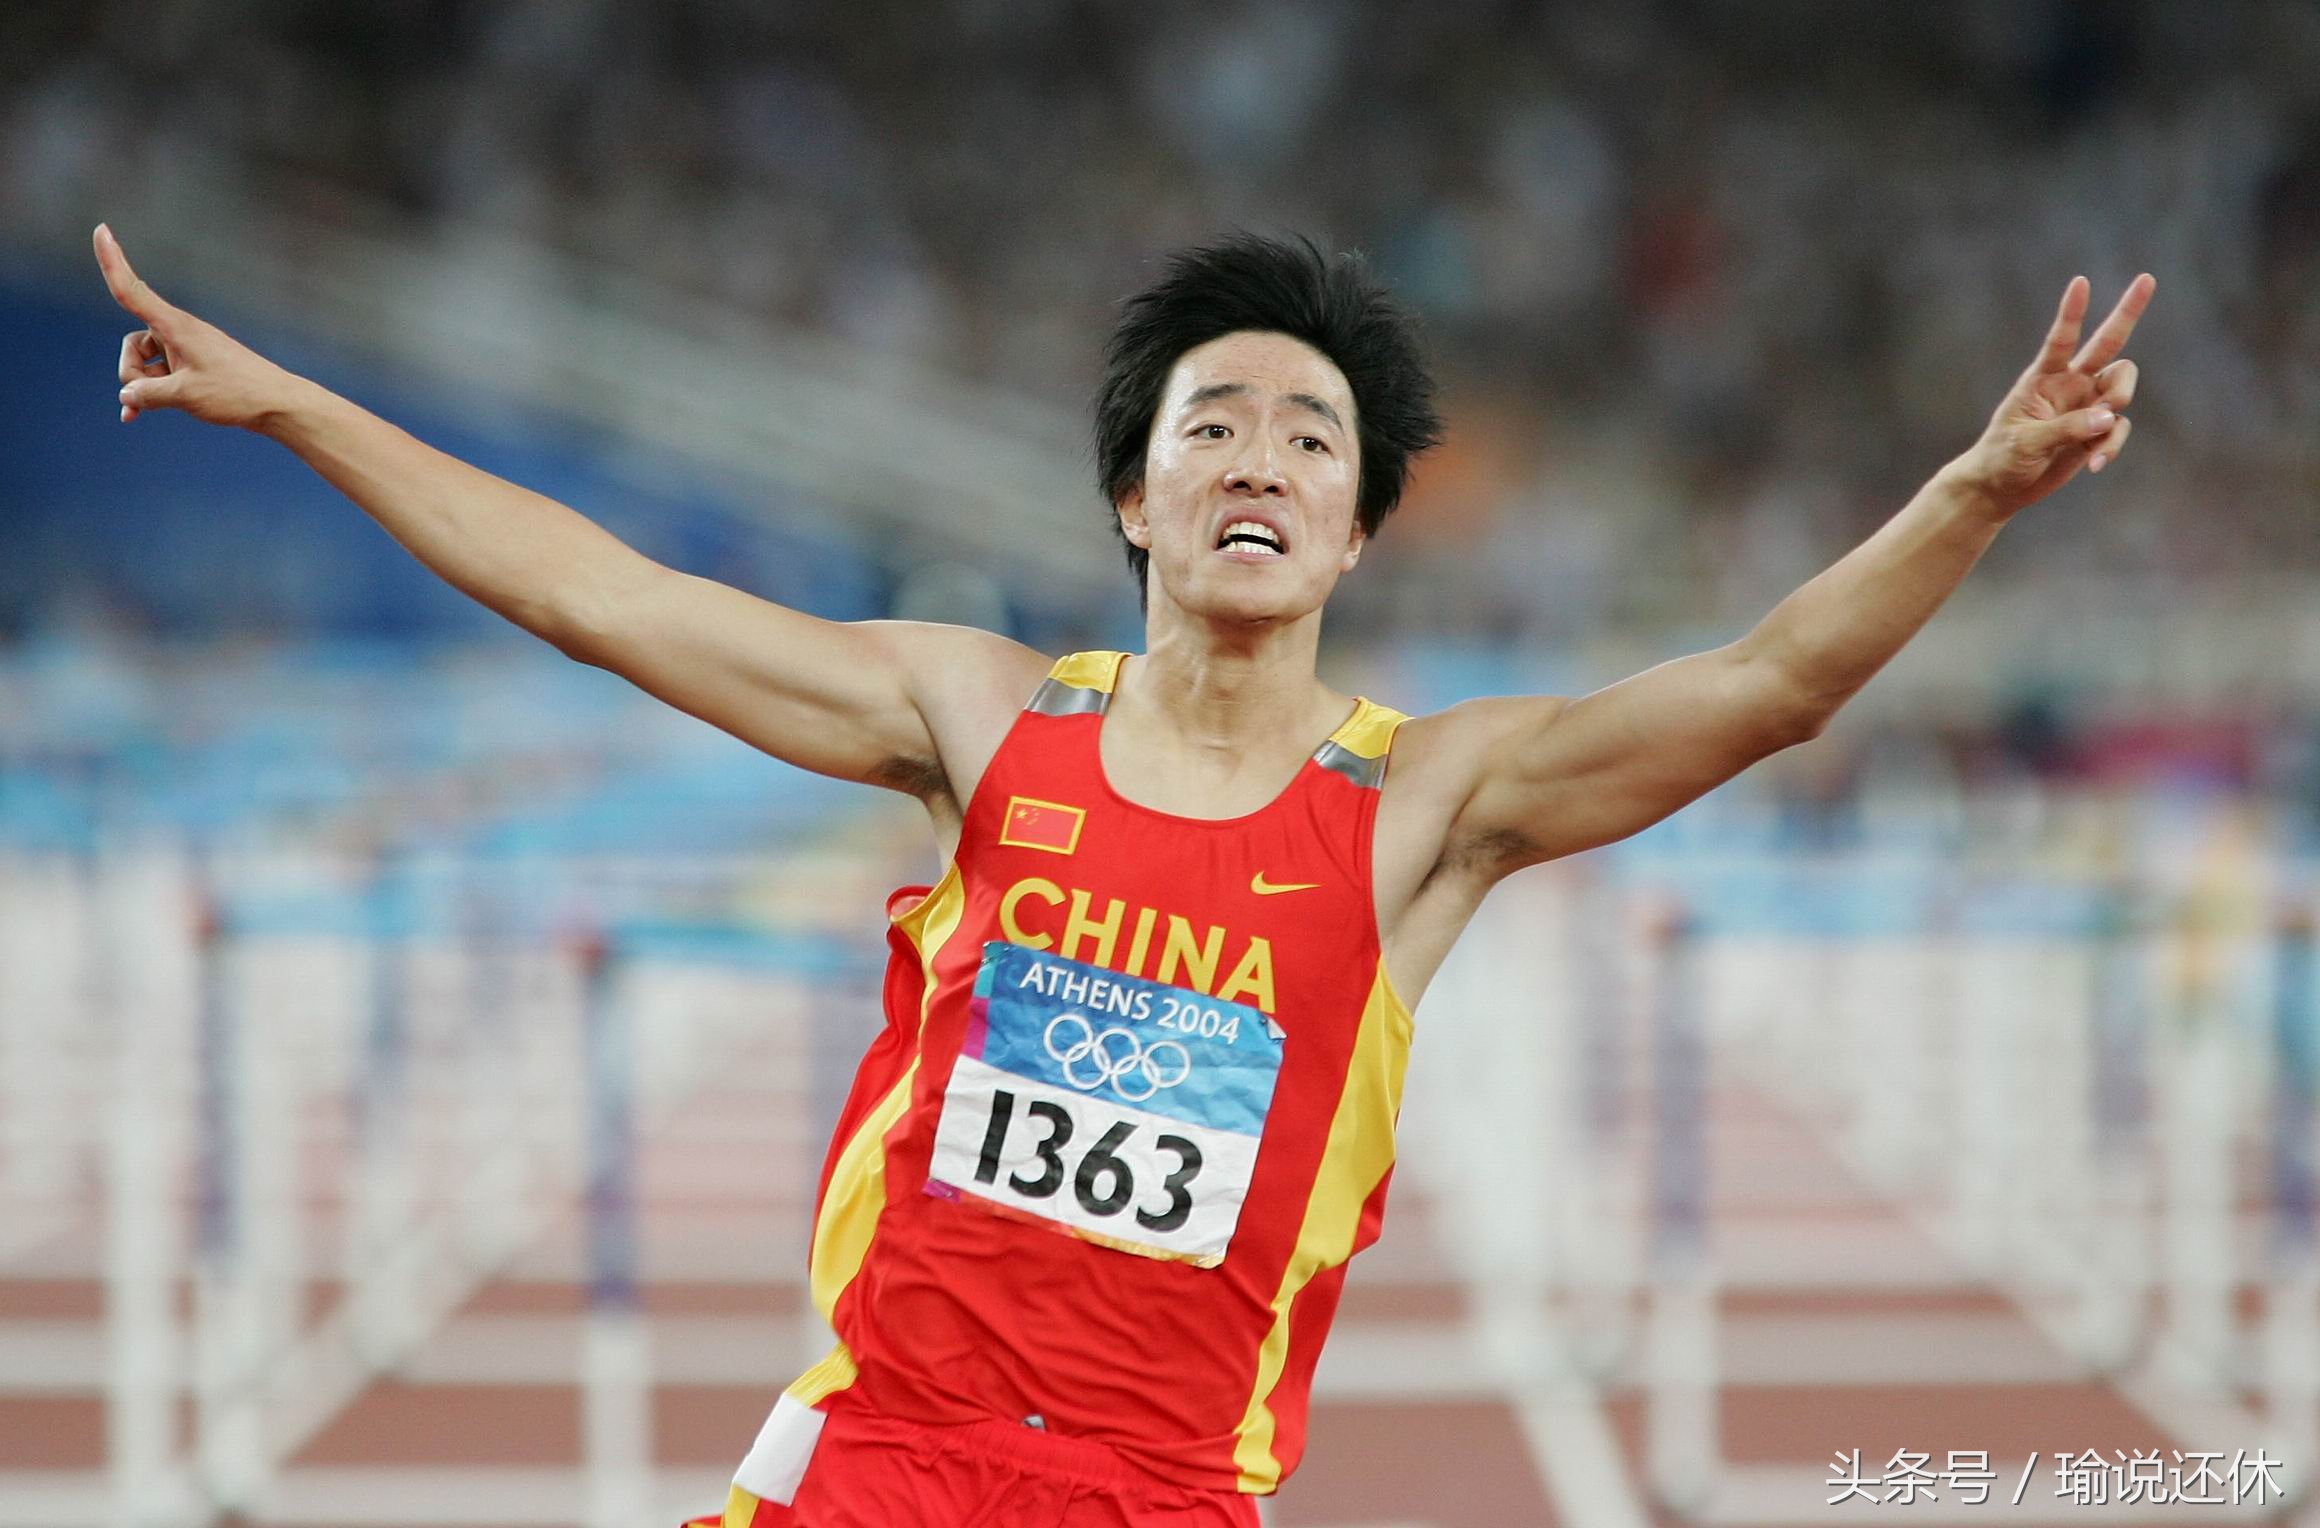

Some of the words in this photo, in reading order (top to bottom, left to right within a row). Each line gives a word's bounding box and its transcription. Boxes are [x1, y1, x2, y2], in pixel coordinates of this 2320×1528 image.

[1000, 877, 1276, 1013] CHINA
[1019, 962, 1153, 1021] ATHENS
[1157, 998, 1241, 1044] 2004
[974, 1088, 1202, 1234] 1363
